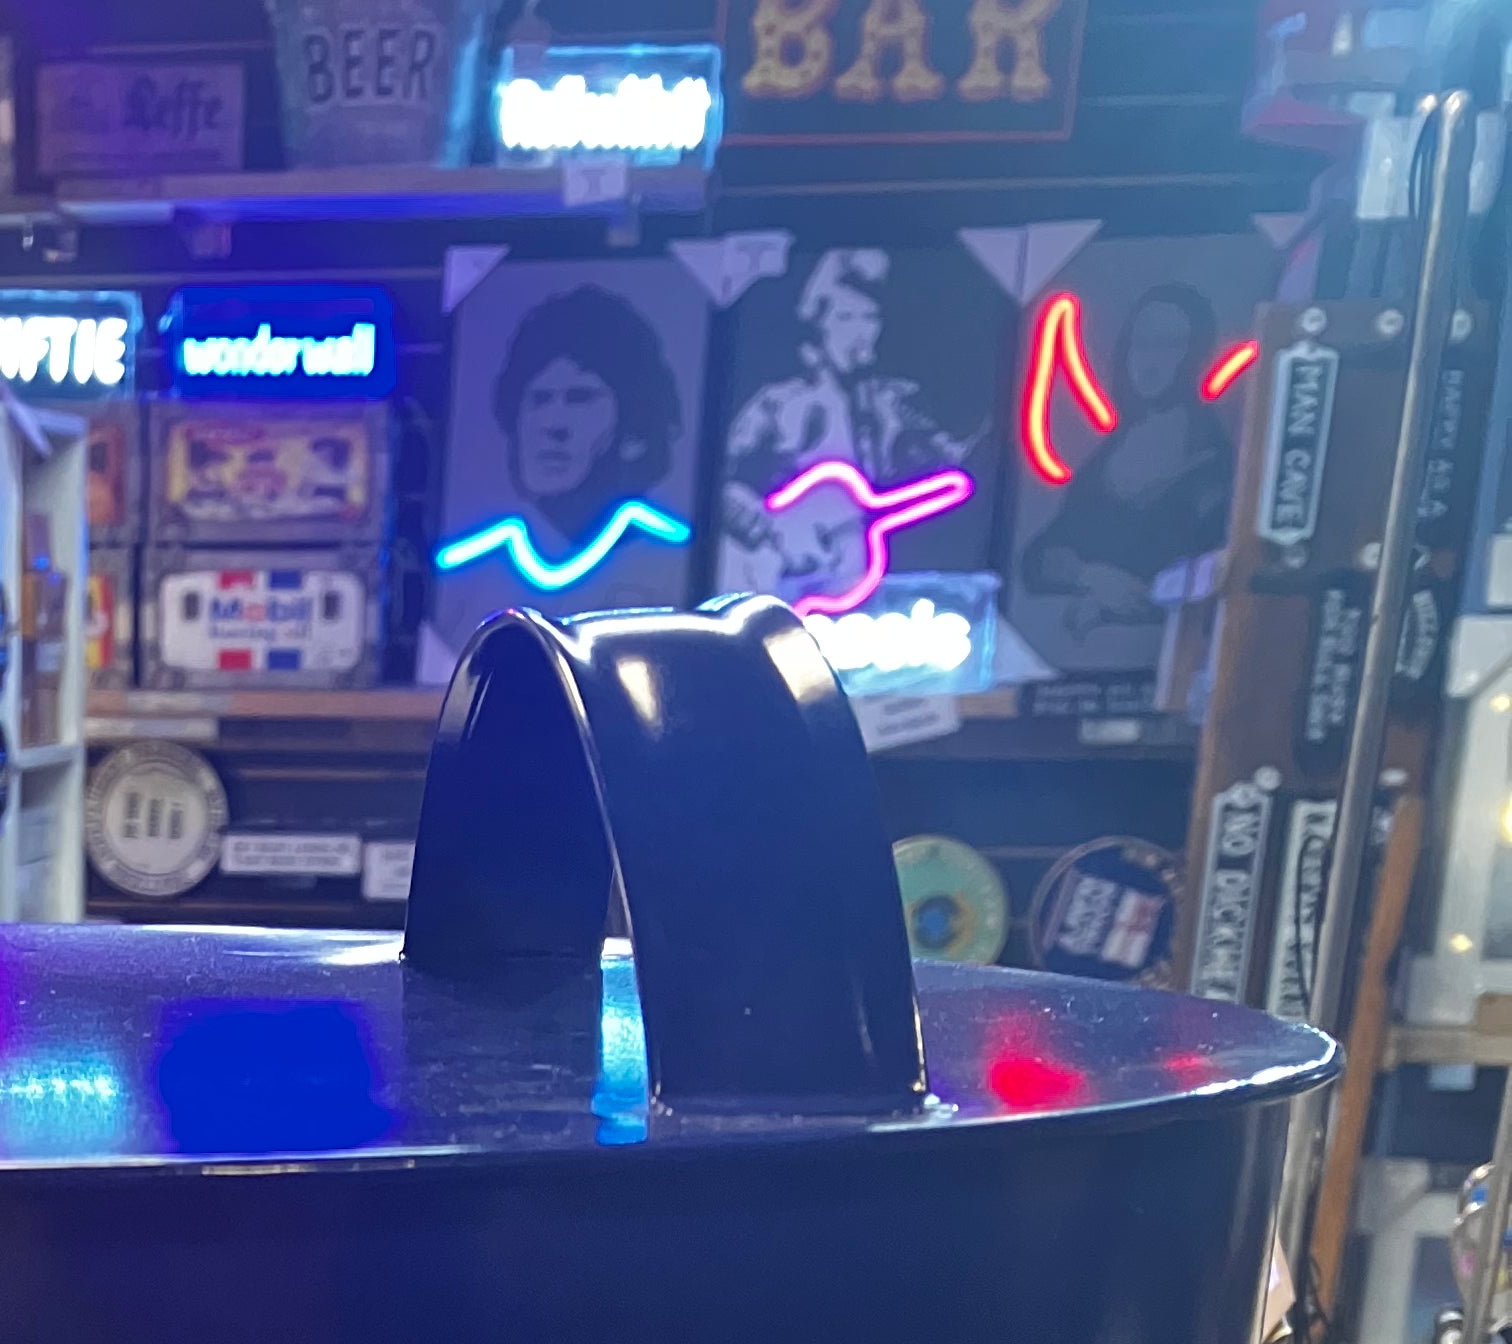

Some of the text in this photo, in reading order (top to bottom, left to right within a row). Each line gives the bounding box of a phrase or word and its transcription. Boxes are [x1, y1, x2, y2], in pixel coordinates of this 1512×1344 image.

[301, 28, 435, 101] BEER
[742, 0, 1063, 100] BAR
[1274, 363, 1324, 527] MAN CAVE
[1221, 810, 1260, 857] NO
